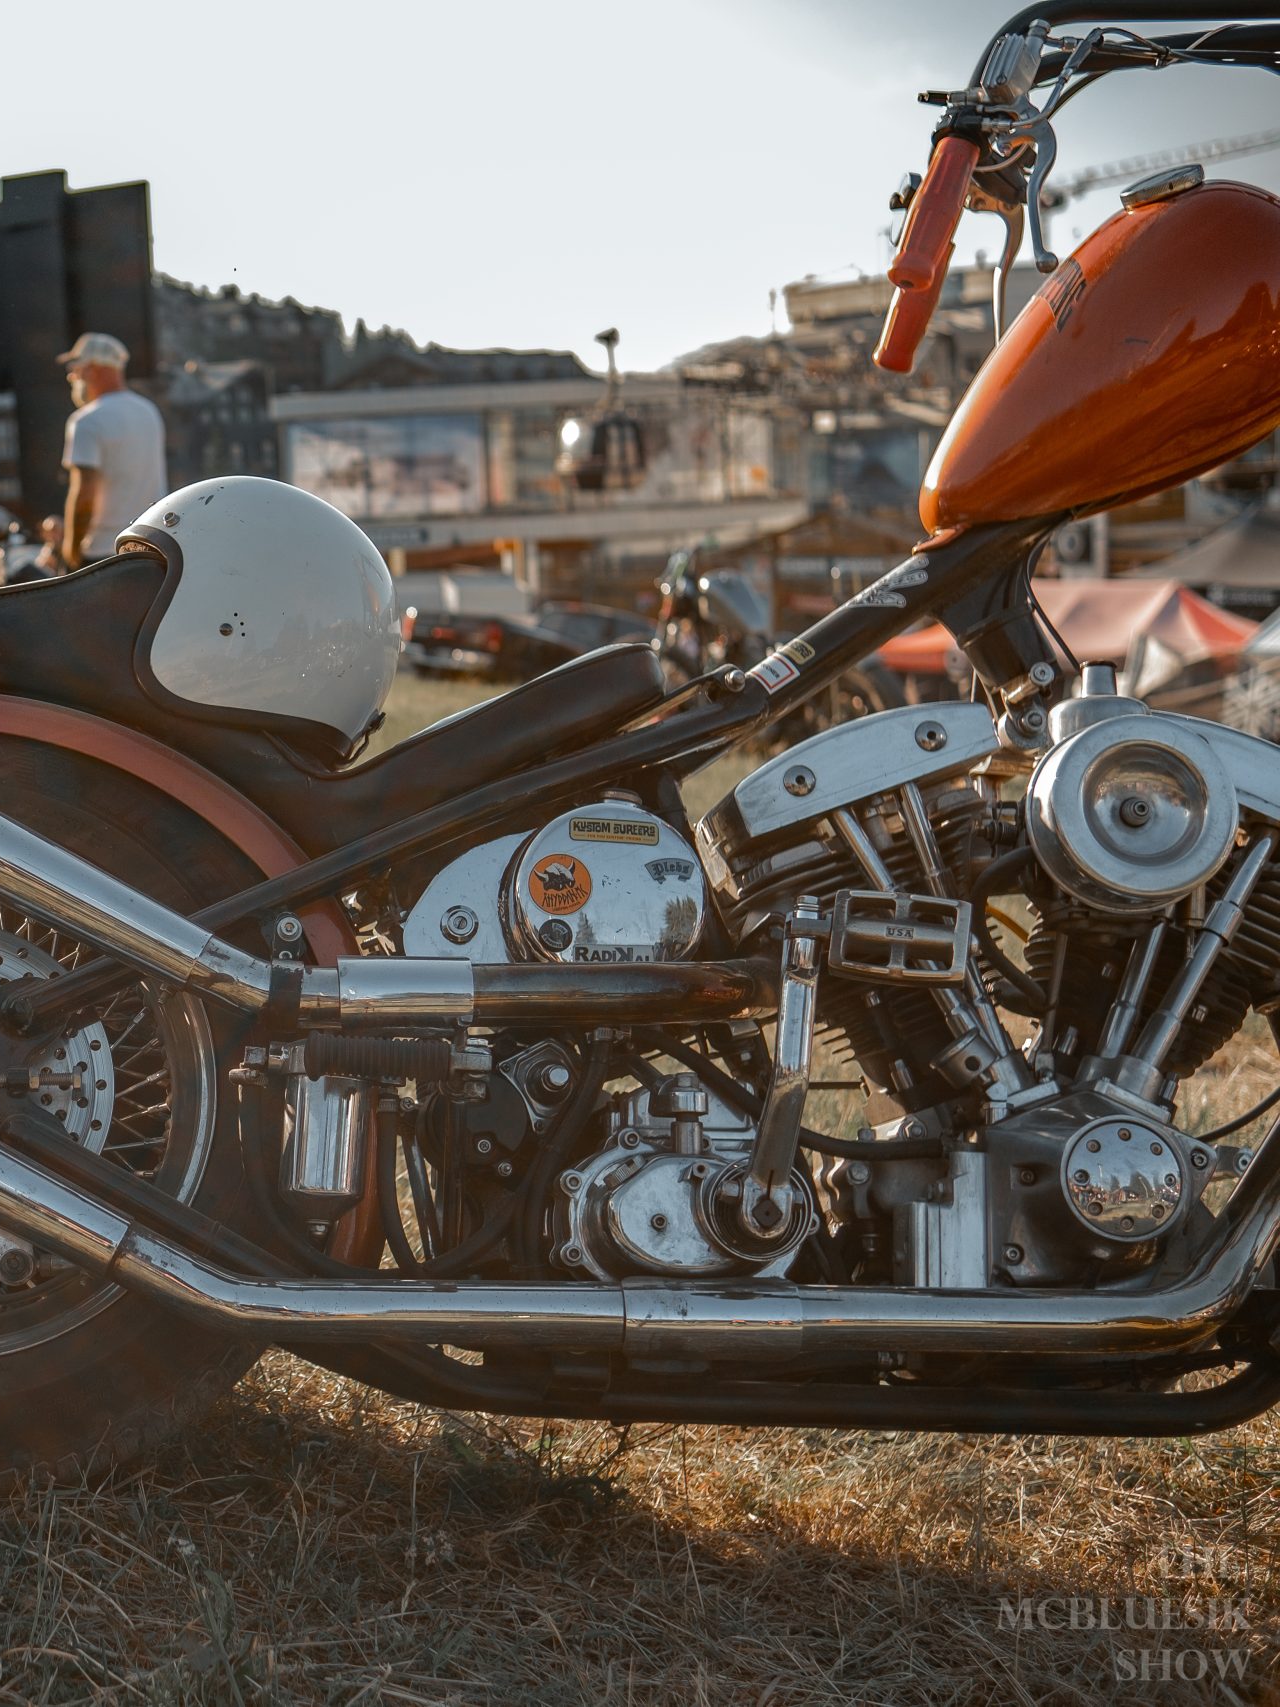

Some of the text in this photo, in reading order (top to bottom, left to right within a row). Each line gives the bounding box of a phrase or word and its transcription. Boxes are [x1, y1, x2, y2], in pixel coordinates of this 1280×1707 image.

[573, 820, 611, 834] KUSTOM
[651, 861, 690, 875] Plebs
[887, 927, 913, 938] USA
